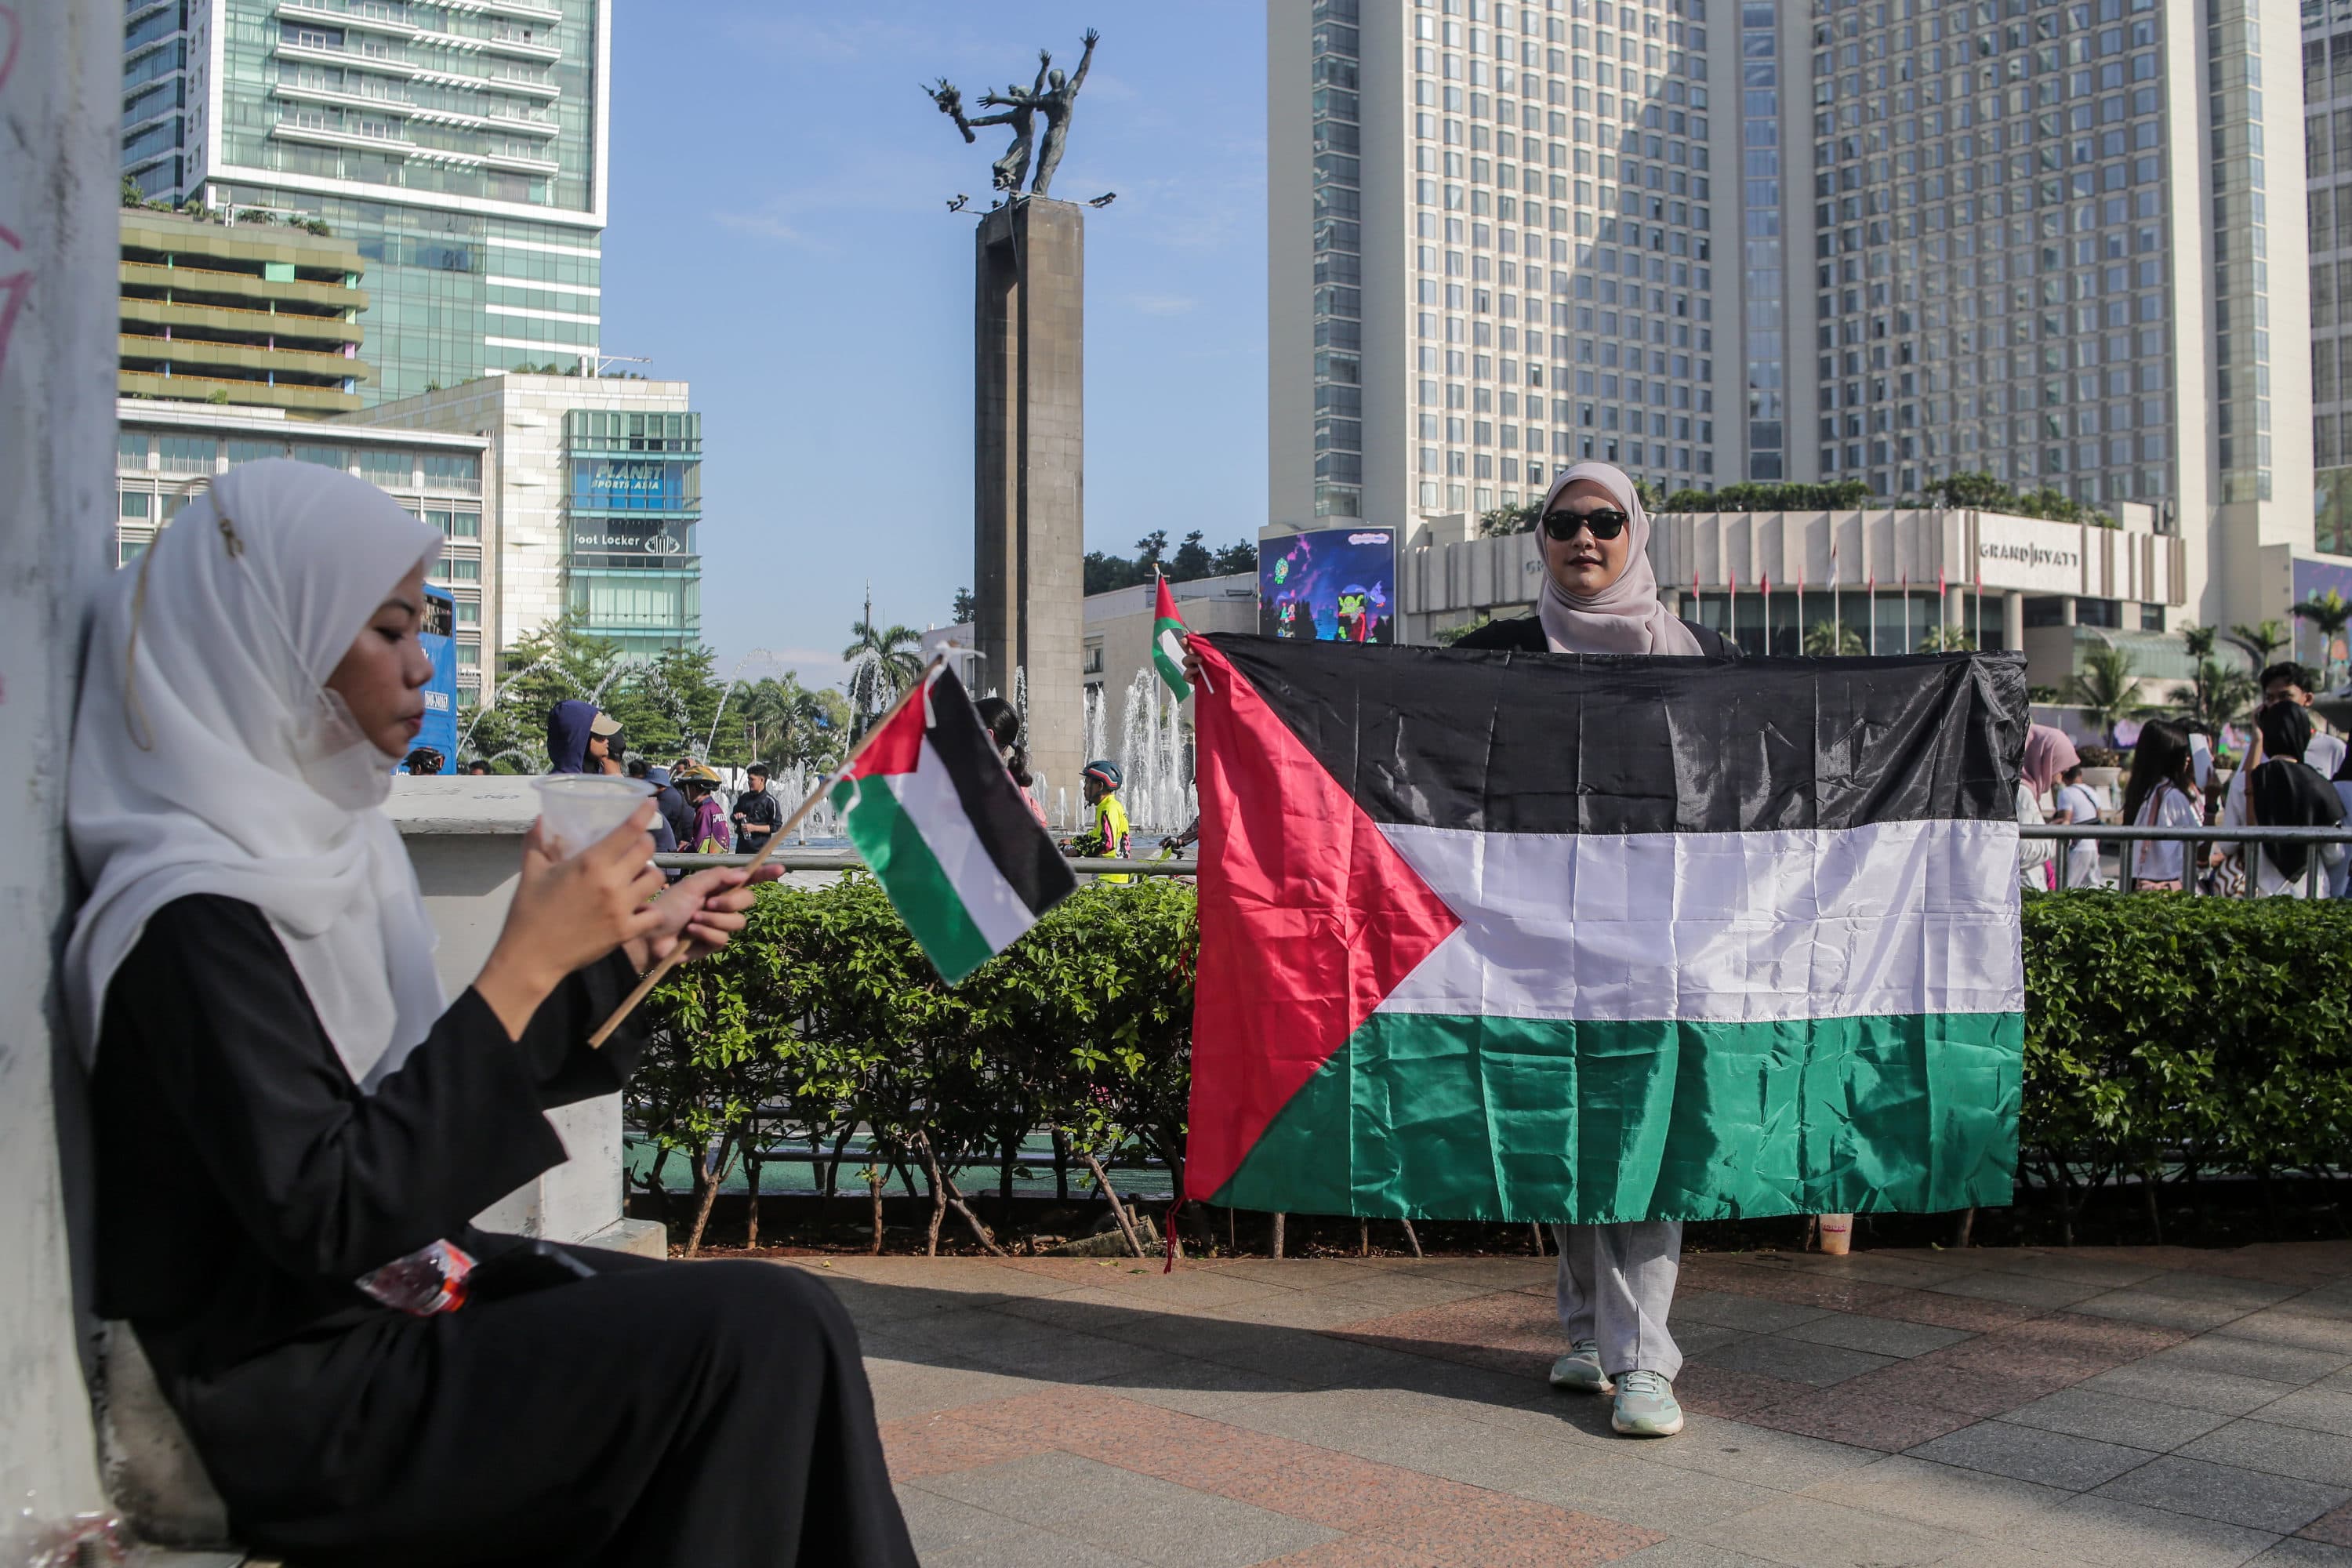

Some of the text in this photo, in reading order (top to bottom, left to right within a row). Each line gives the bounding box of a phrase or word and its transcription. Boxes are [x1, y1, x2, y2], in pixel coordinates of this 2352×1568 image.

[596, 465, 663, 480] PLANET
[575, 534, 641, 546] Foot Locker
[1980, 543, 2078, 567] GRAND HYATT
